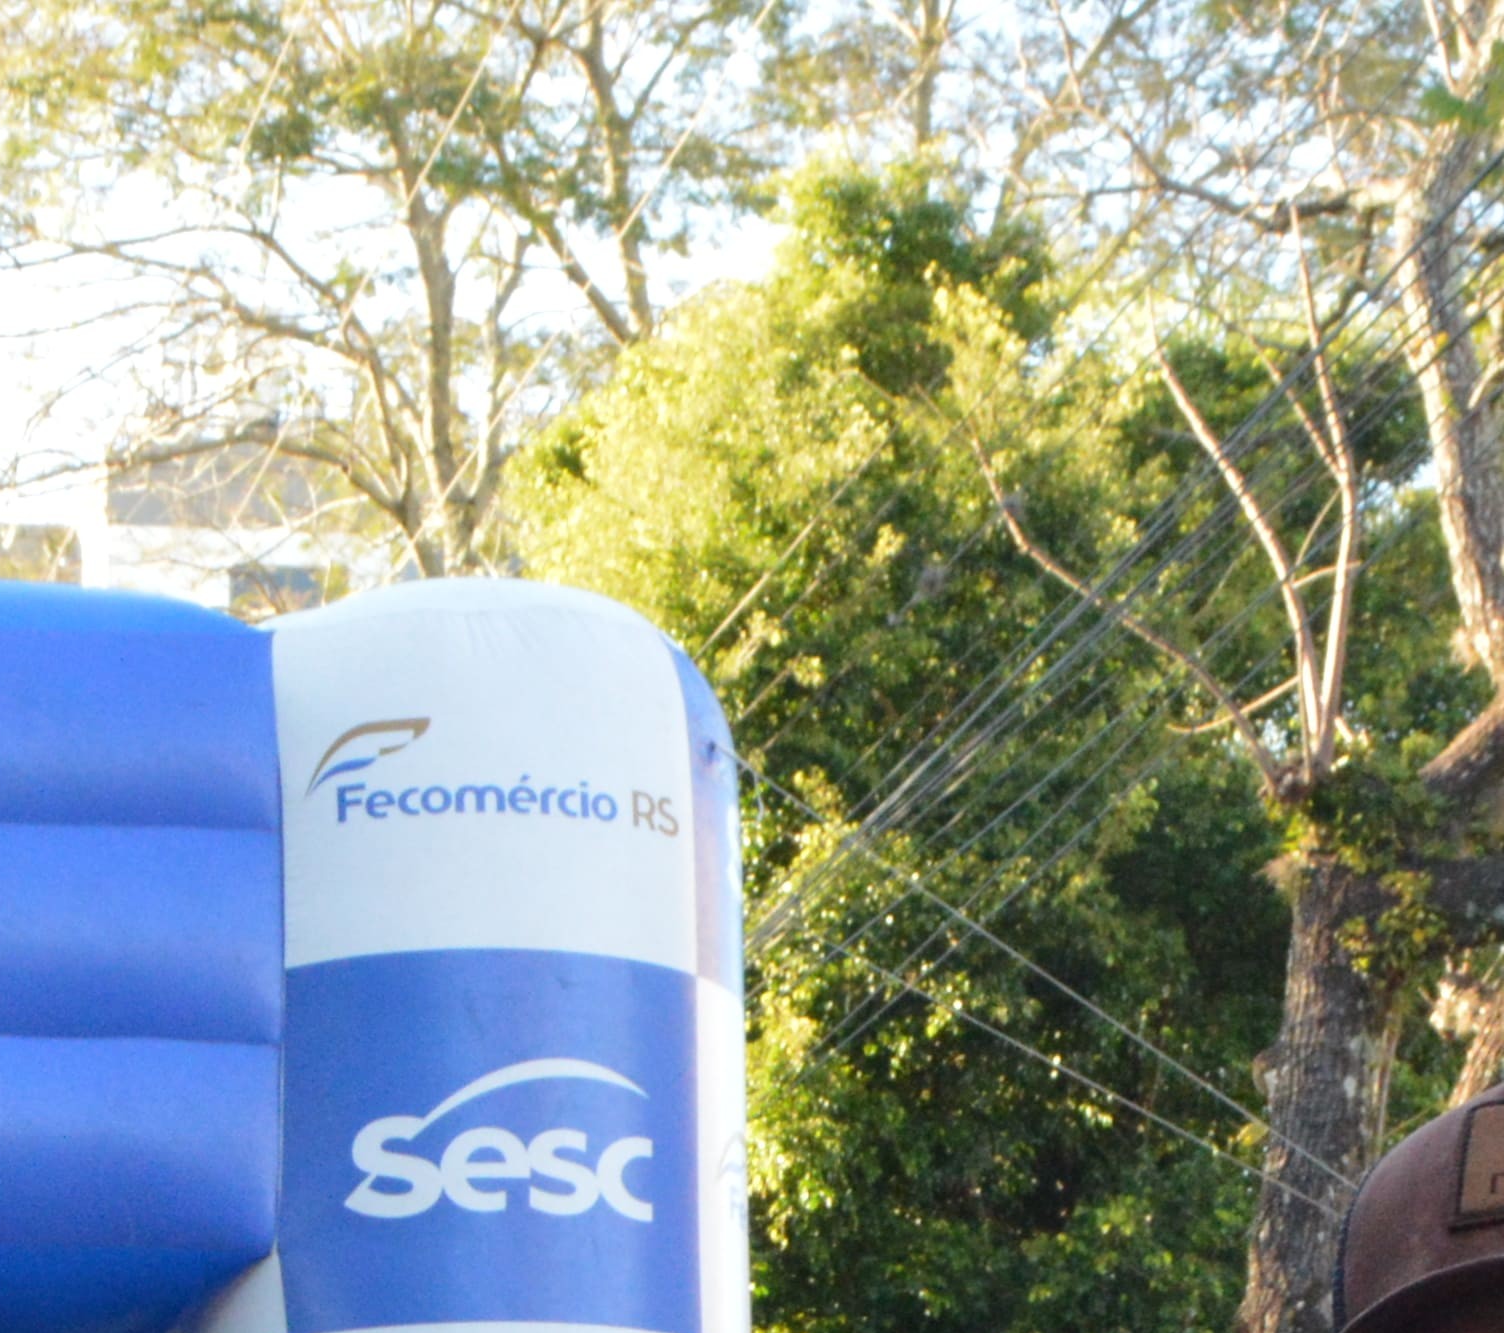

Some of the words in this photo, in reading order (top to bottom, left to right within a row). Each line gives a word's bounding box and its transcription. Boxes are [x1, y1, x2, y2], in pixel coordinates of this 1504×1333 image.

[335, 775, 617, 823] Fecomércio
[632, 791, 679, 836] RS
[343, 1115, 653, 1222] Sesc
